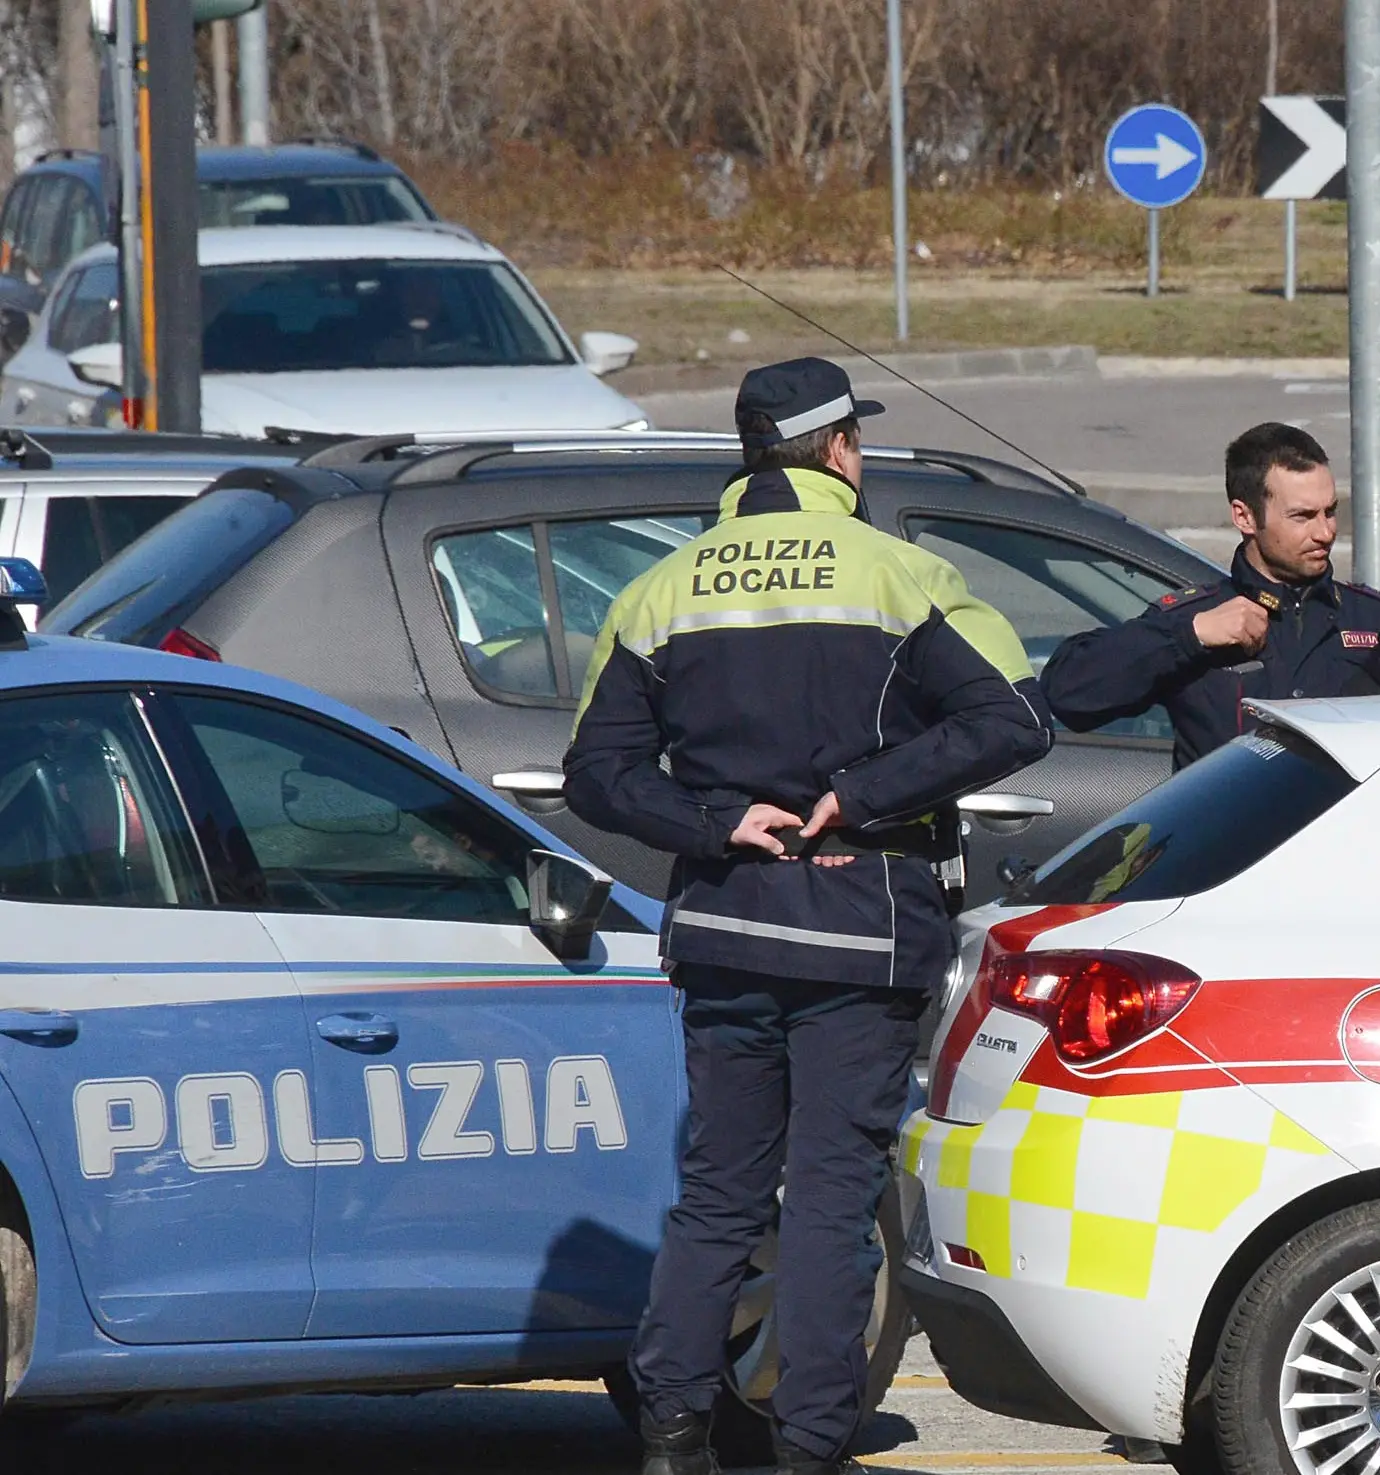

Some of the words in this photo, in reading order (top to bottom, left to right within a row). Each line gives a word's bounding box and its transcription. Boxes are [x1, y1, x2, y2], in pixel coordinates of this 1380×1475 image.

[695, 539, 836, 568] POLIZIA
[692, 566, 835, 596] LOCALE
[72, 1054, 627, 1180] POLIZIA
